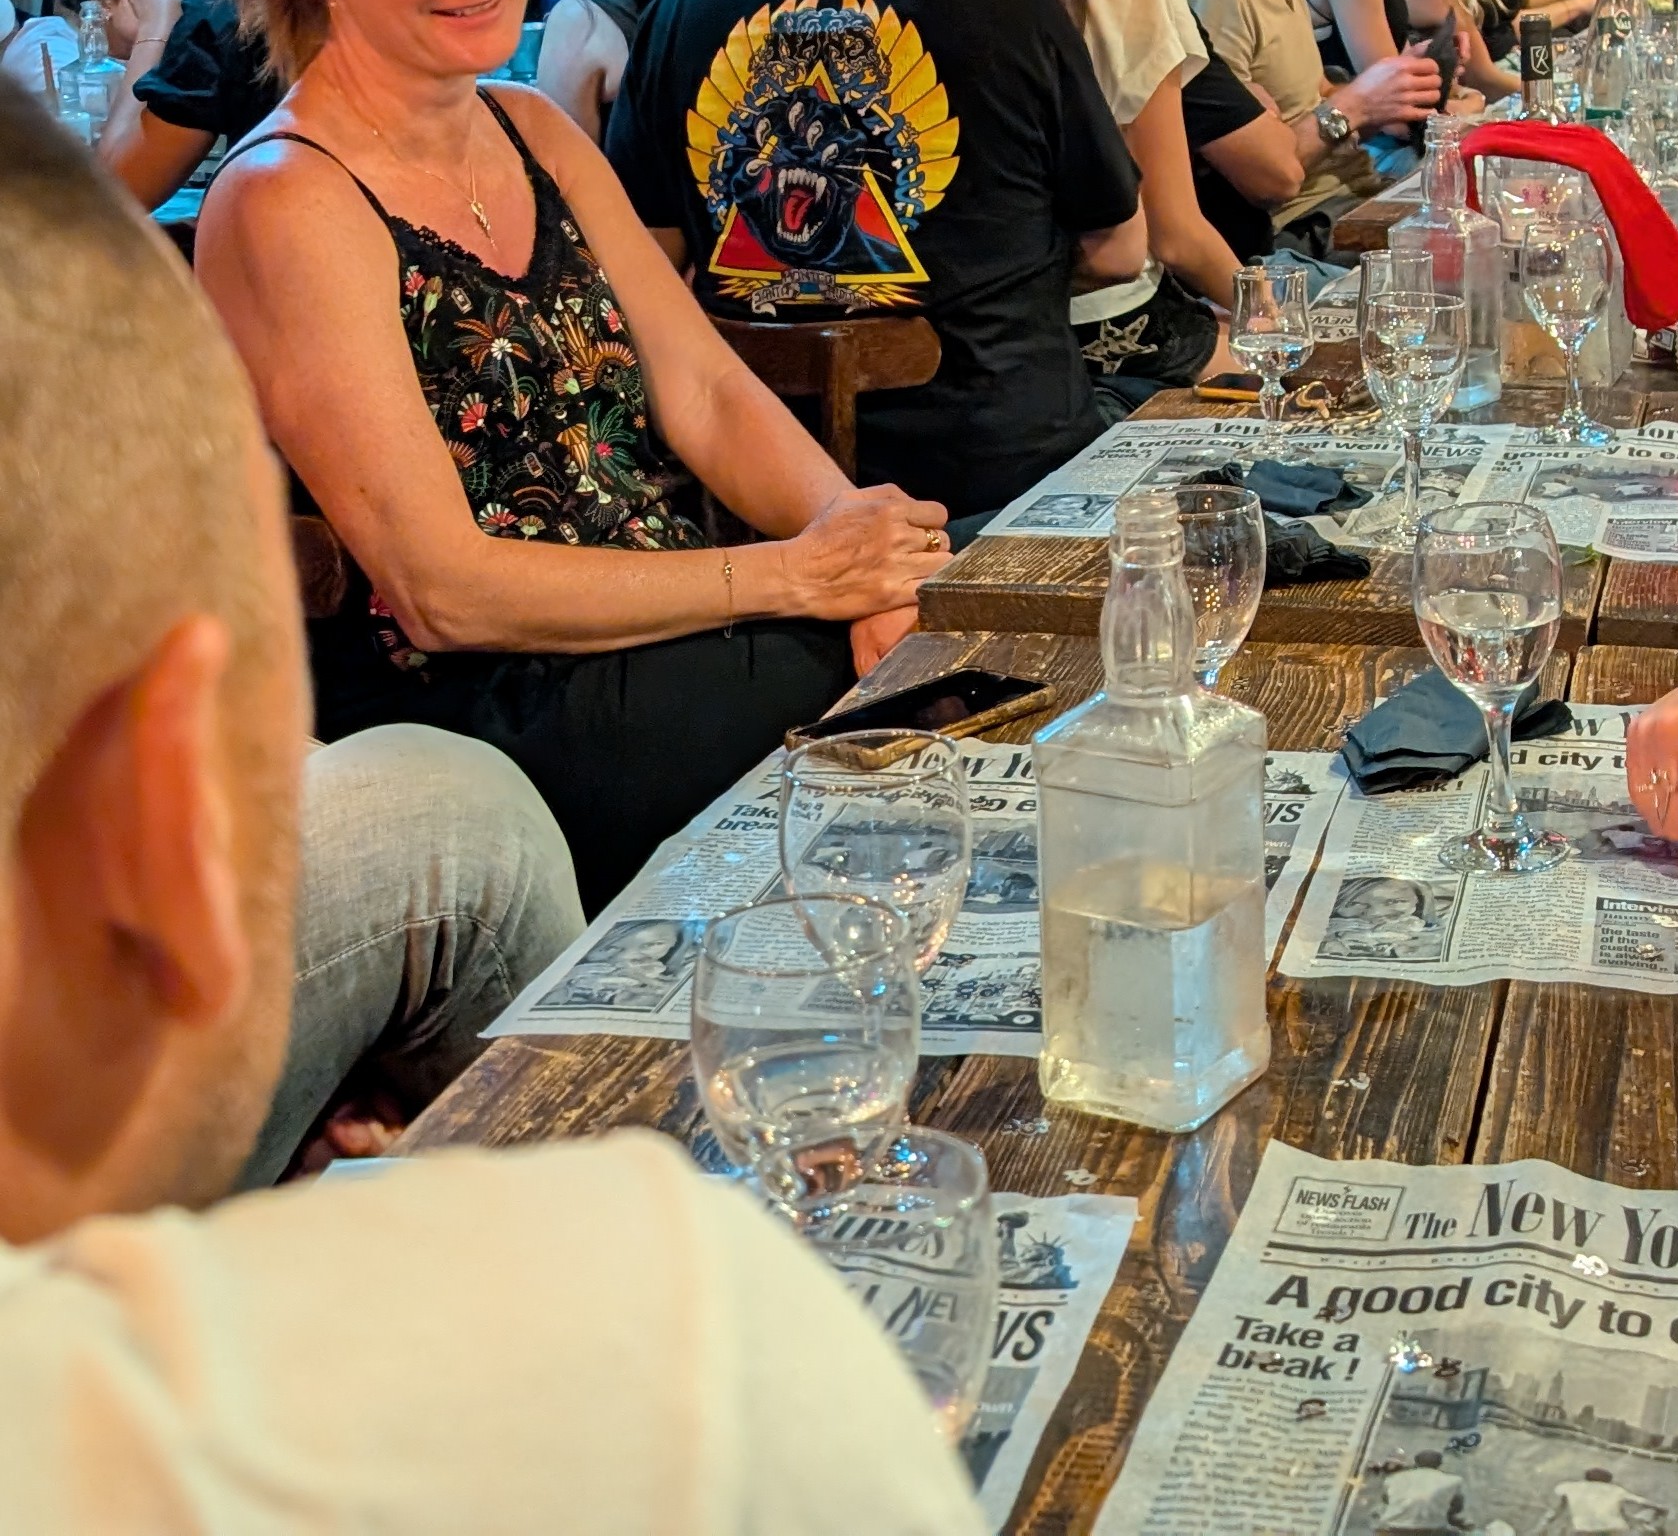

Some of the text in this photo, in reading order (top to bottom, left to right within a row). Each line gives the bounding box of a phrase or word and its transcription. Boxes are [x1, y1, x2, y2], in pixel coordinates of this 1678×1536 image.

[1208, 421, 1261, 435] New
[1112, 439, 1134, 449] A
[1136, 438, 1197, 451] good
[1201, 436, 1254, 451] city
[1334, 441, 1391, 452] well
[1421, 445, 1484, 458] NEWS
[1502, 450, 1570, 462] good
[1627, 447, 1652, 459] to
[1537, 748, 1604, 770] city
[714, 817, 779, 831] brea
[1601, 927, 1660, 939] the taste
[1601, 936, 1639, 946] of the
[1599, 951, 1610, 959] is
[1600, 944, 1665, 953] custo
[1599, 957, 1659, 971] evolving
[1296, 1189, 1341, 1209] NEWS
[1344, 1194, 1391, 1212] FLASH
[1405, 1212, 1458, 1240] The
[1466, 1179, 1605, 1248] New
[1266, 1275, 1309, 1308] A
[1316, 1277, 1473, 1322] good
[1485, 1273, 1586, 1330] city
[1598, 1300, 1652, 1338] to
[1235, 1315, 1360, 1354] Take a
[1217, 1342, 1361, 1382] break !
